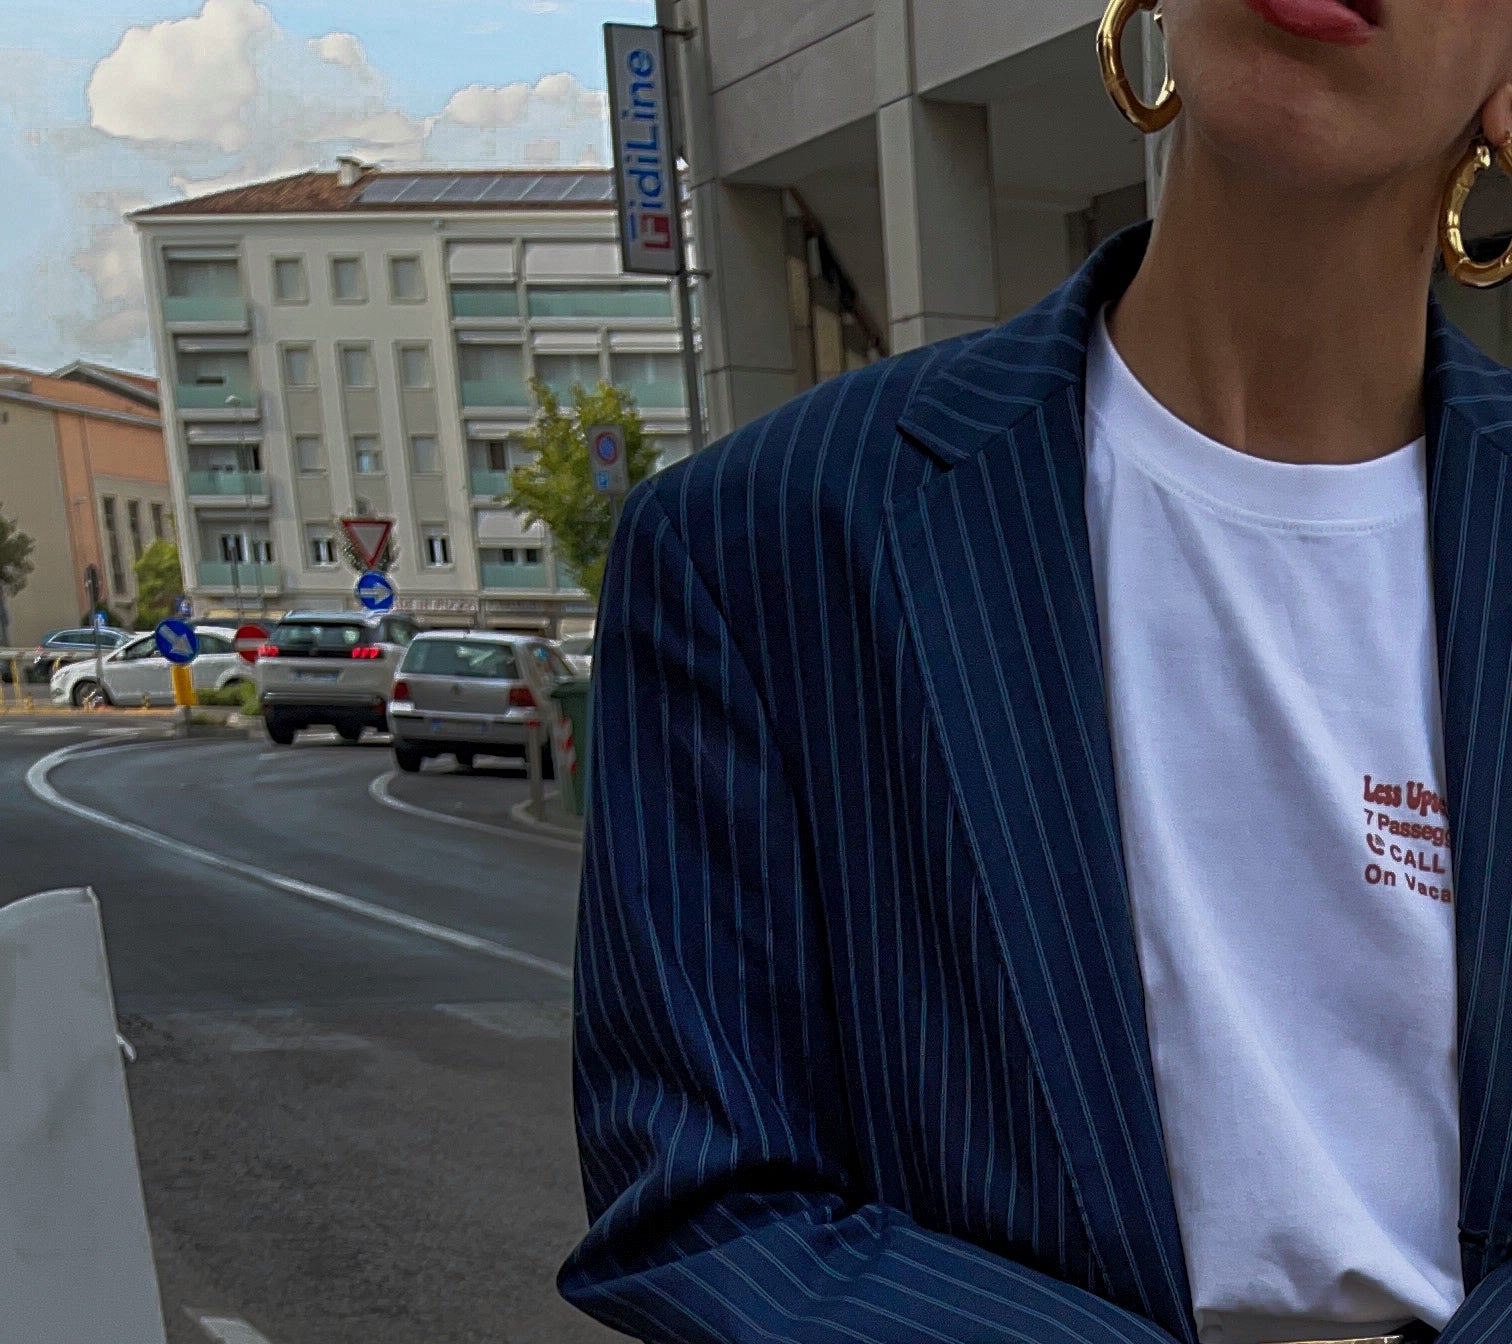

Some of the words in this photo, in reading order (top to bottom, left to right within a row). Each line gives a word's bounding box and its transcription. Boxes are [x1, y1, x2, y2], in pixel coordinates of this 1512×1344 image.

[620, 49, 671, 249] FidiLine
[1389, 844, 1446, 874] CALL
[1364, 863, 1396, 886] On
